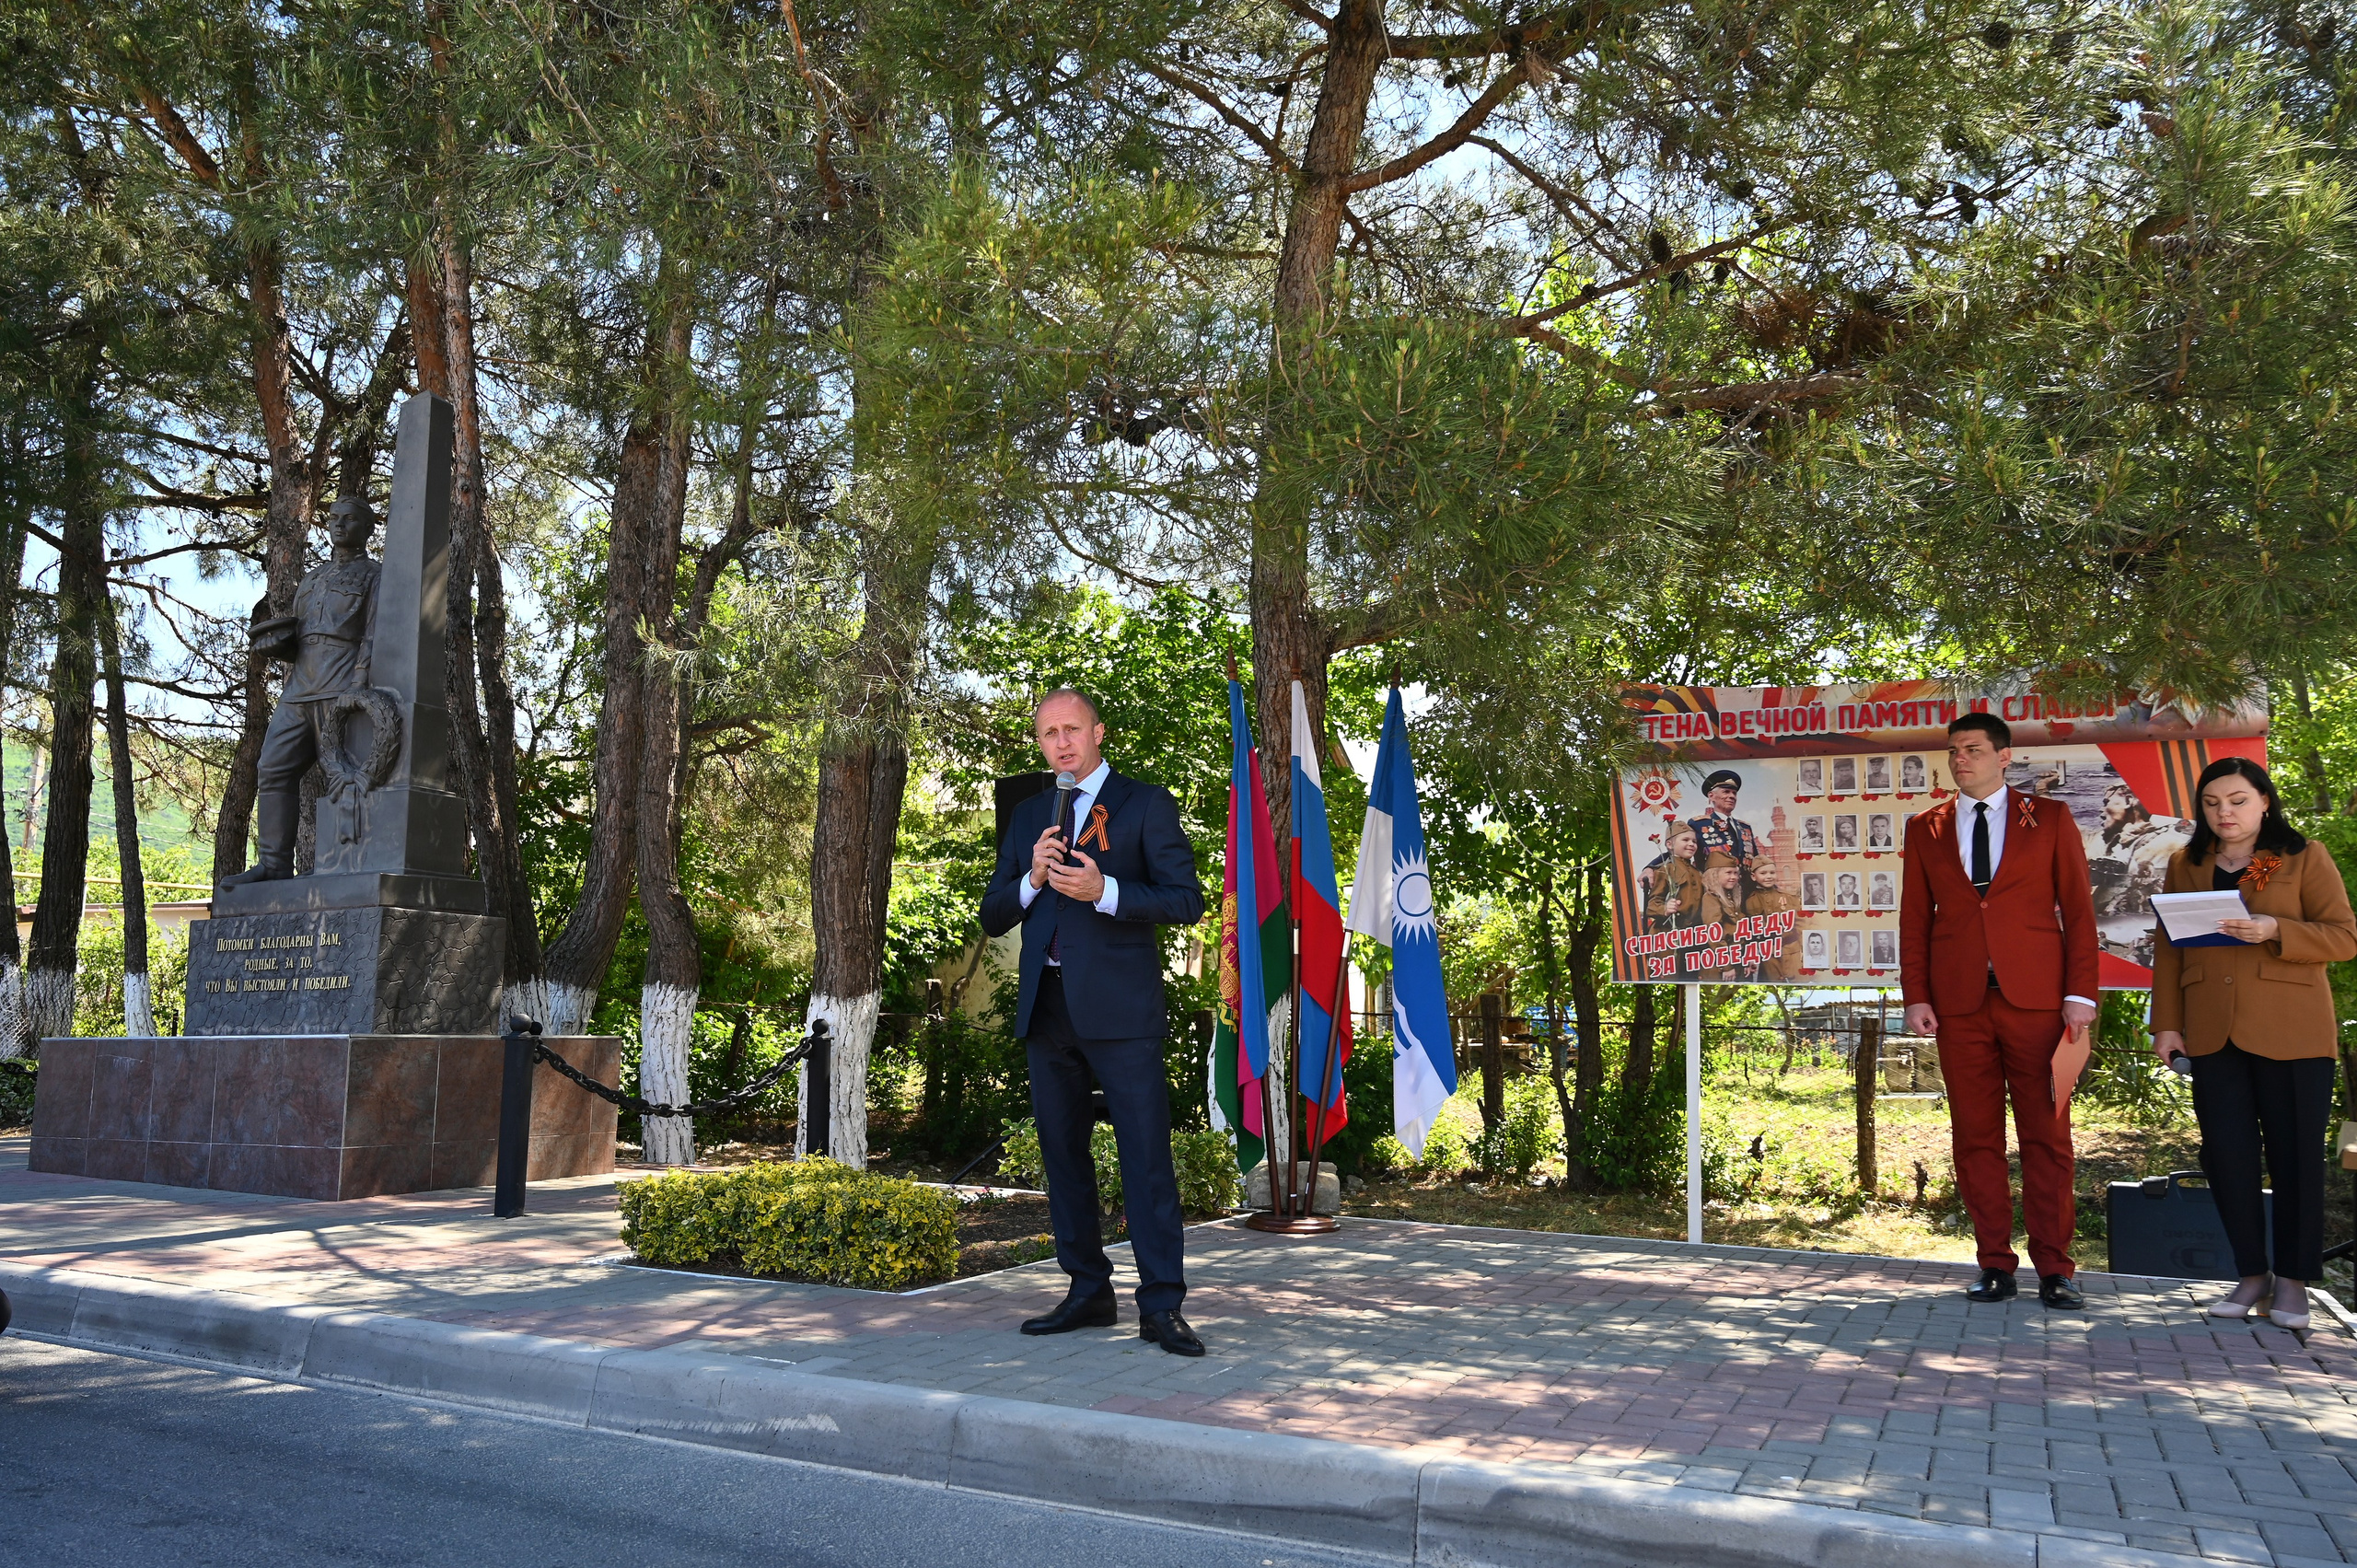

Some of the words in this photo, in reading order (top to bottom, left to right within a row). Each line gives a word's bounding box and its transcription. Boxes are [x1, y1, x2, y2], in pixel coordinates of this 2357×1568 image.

[1719, 701, 1827, 736] ВЕЧНОЙ
[1838, 699, 1957, 730] ПАМЯТИ
[1625, 922, 1724, 957] СПАСИБО
[1734, 909, 1795, 942] ДЕДУ
[1648, 955, 1677, 978] ЗА
[1686, 937, 1782, 972] ПОБЕДУ!
